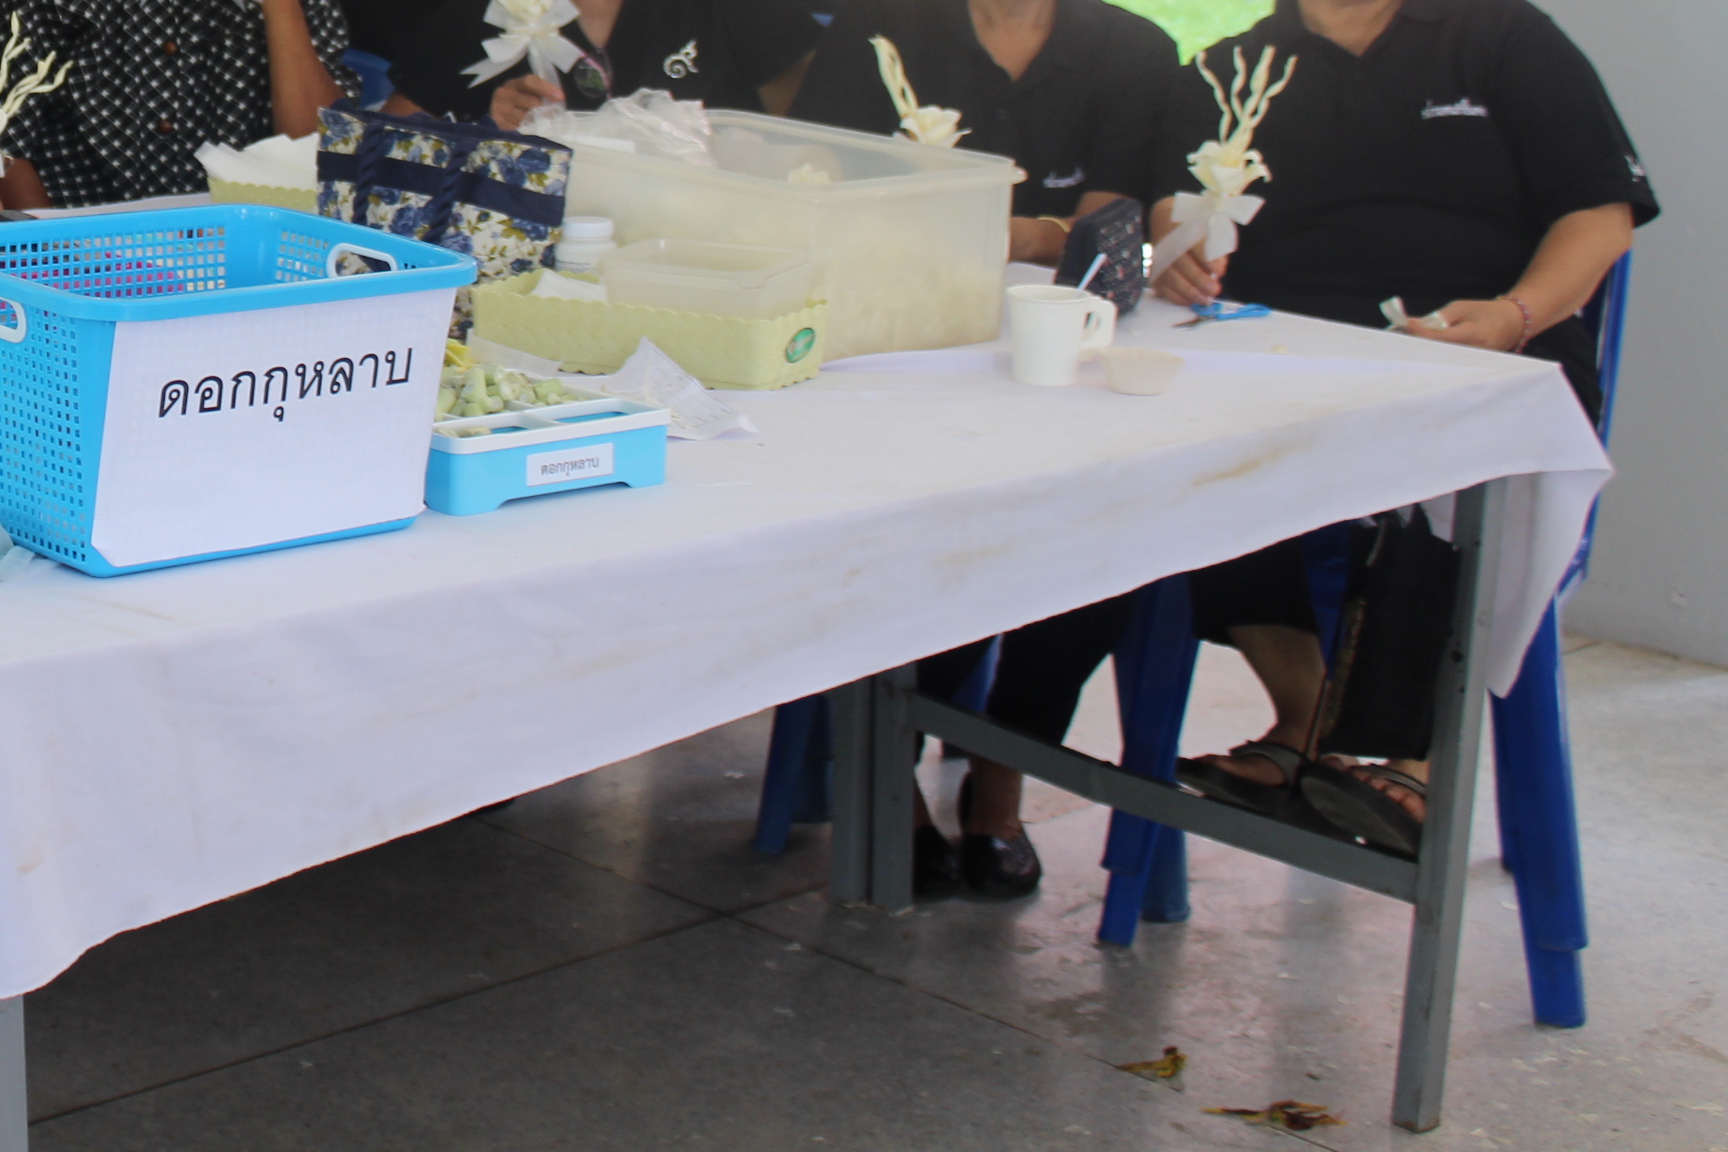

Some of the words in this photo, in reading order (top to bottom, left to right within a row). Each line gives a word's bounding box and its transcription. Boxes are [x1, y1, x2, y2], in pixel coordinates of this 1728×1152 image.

[157, 347, 414, 423] ดอกกุหลาบ
[540, 456, 600, 477] ดอกกุหลาบ
